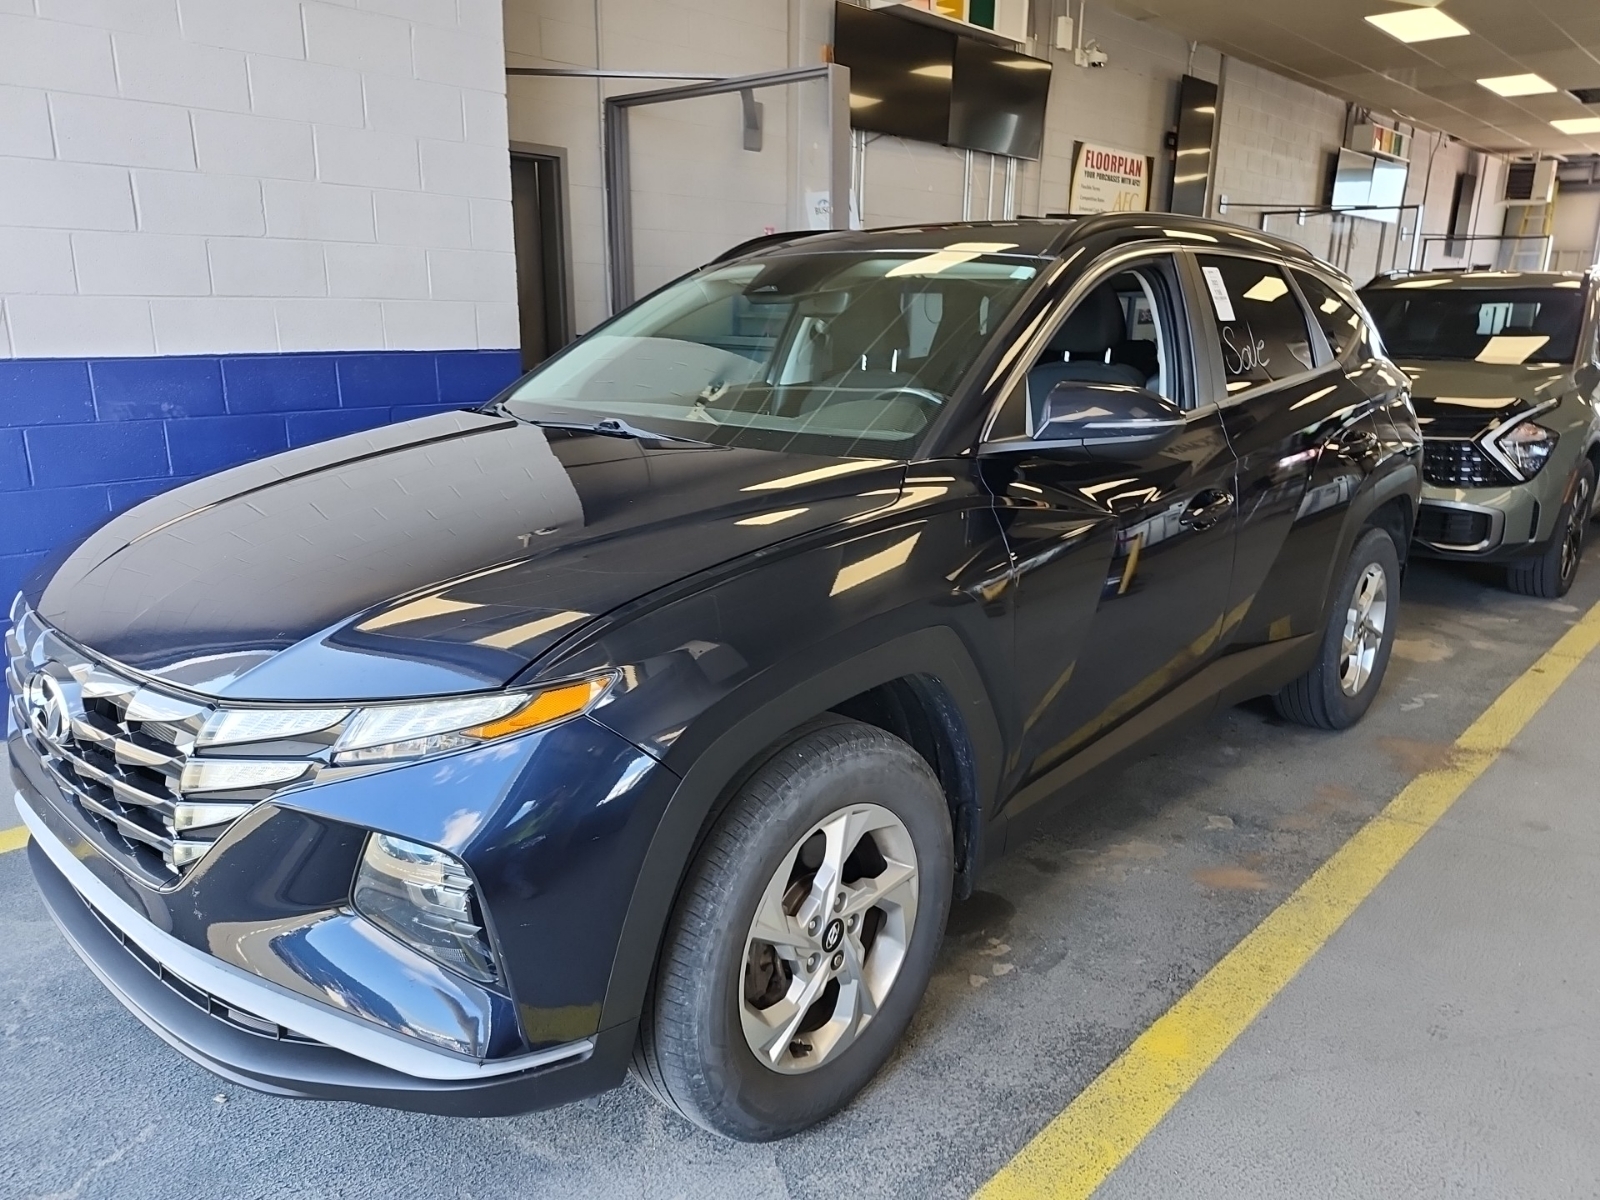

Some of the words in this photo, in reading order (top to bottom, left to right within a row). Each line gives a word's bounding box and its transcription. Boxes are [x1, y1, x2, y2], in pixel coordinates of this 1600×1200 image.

[1085, 149, 1142, 177] FLOORPLAN
[1084, 170, 1095, 179] YOUR
[1096, 172, 1120, 183] PURCHASES
[1113, 191, 1139, 212] AFC
[1222, 320, 1270, 374] Sale
